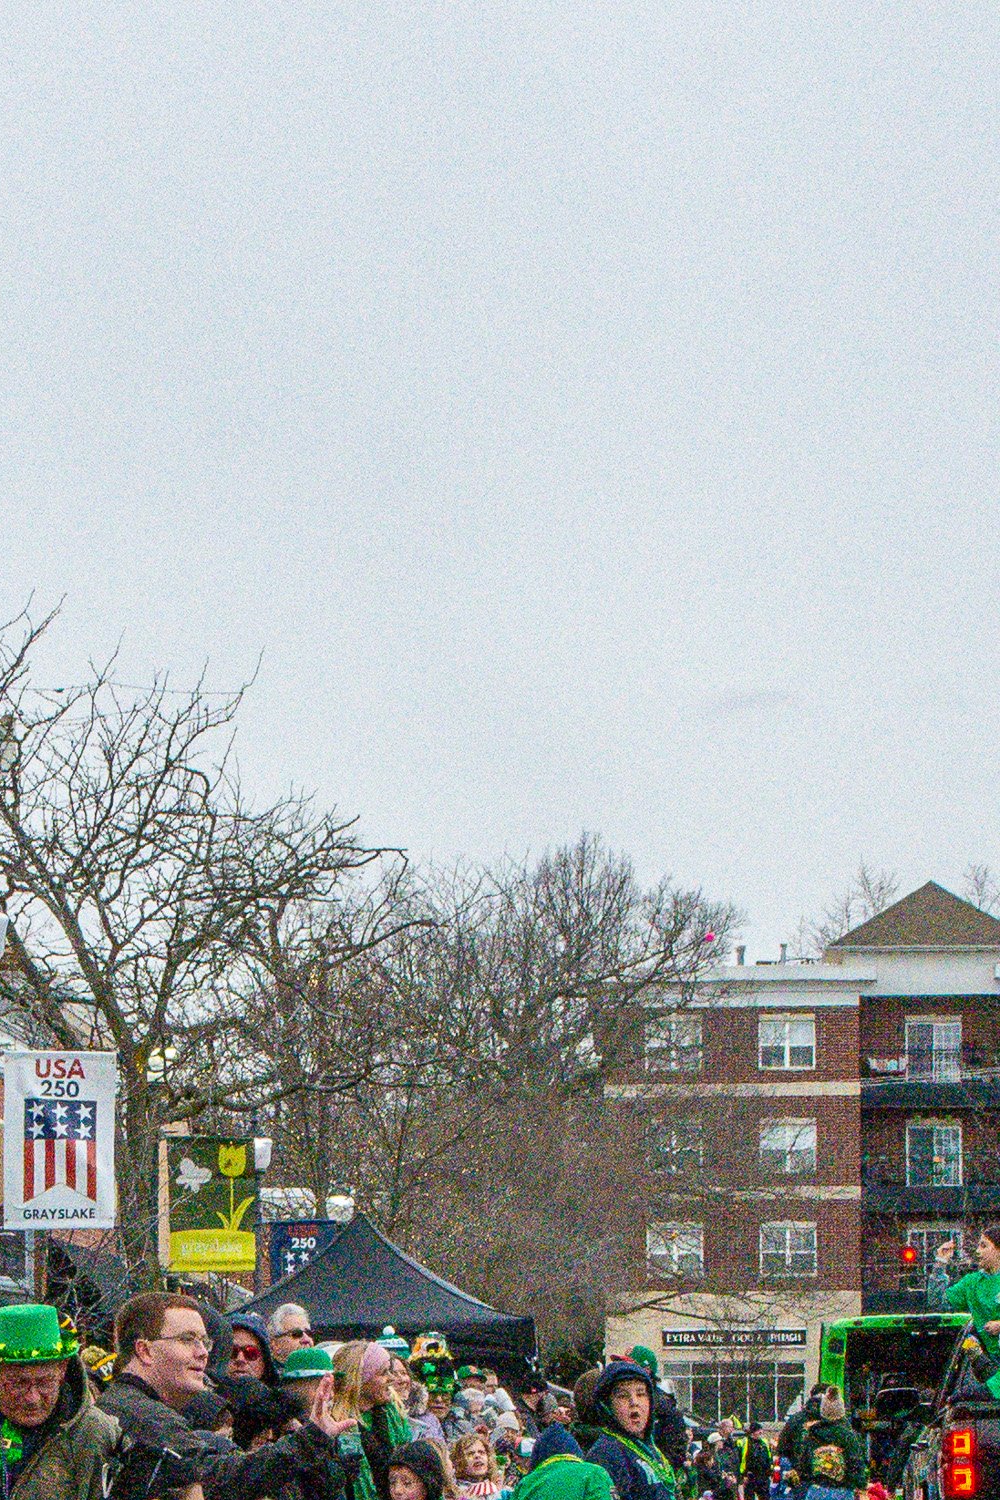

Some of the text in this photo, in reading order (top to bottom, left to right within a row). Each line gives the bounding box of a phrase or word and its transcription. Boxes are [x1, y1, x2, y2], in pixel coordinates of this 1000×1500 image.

[35, 1058, 86, 1079] USA
[40, 1080, 80, 1098] 250
[23, 1208, 96, 1220] GRAYSLAKE
[291, 1237, 317, 1249] 250
[666, 1333, 696, 1343] EXTRA
